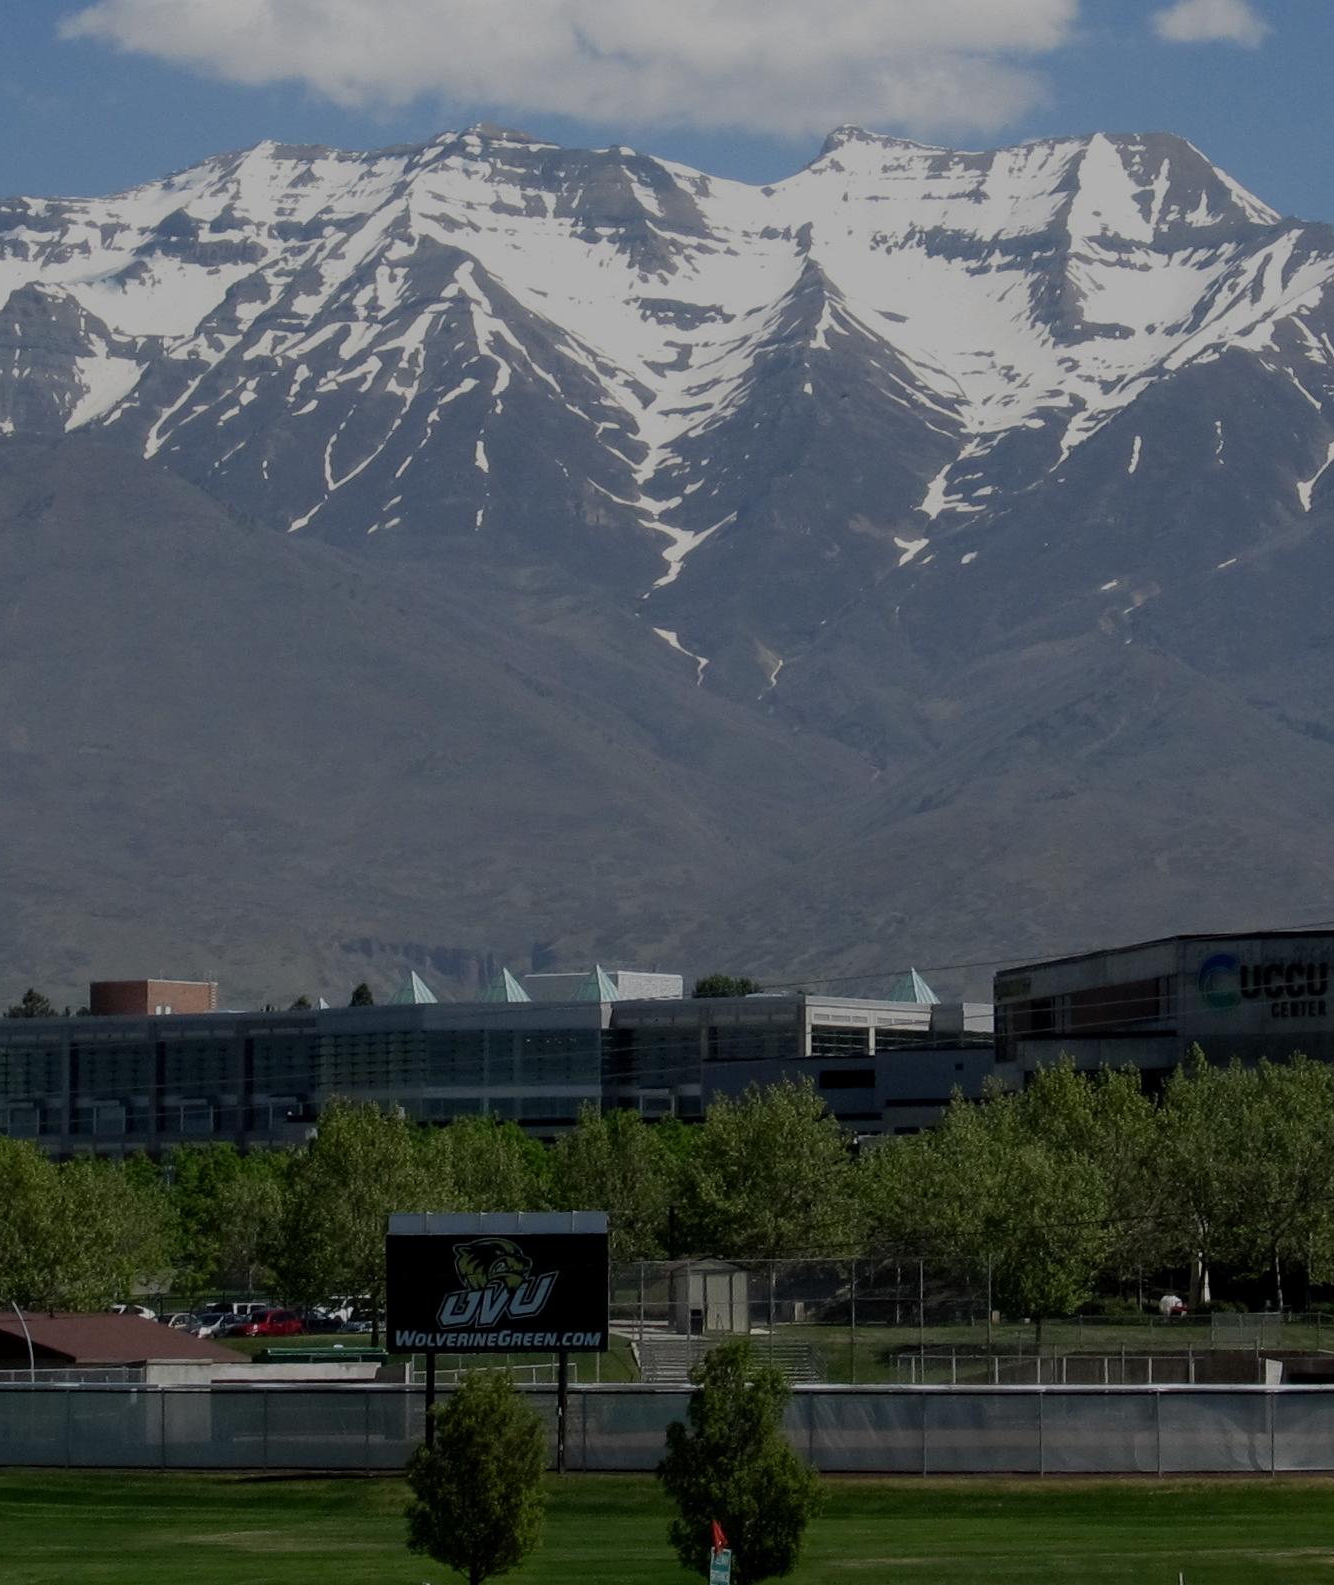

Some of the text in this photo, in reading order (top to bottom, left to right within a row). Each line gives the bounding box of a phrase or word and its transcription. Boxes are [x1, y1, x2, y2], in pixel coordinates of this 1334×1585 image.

[1240, 962, 1328, 999] UCCU
[1271, 1000, 1327, 1018] CENTER
[435, 1271, 560, 1330] UVU
